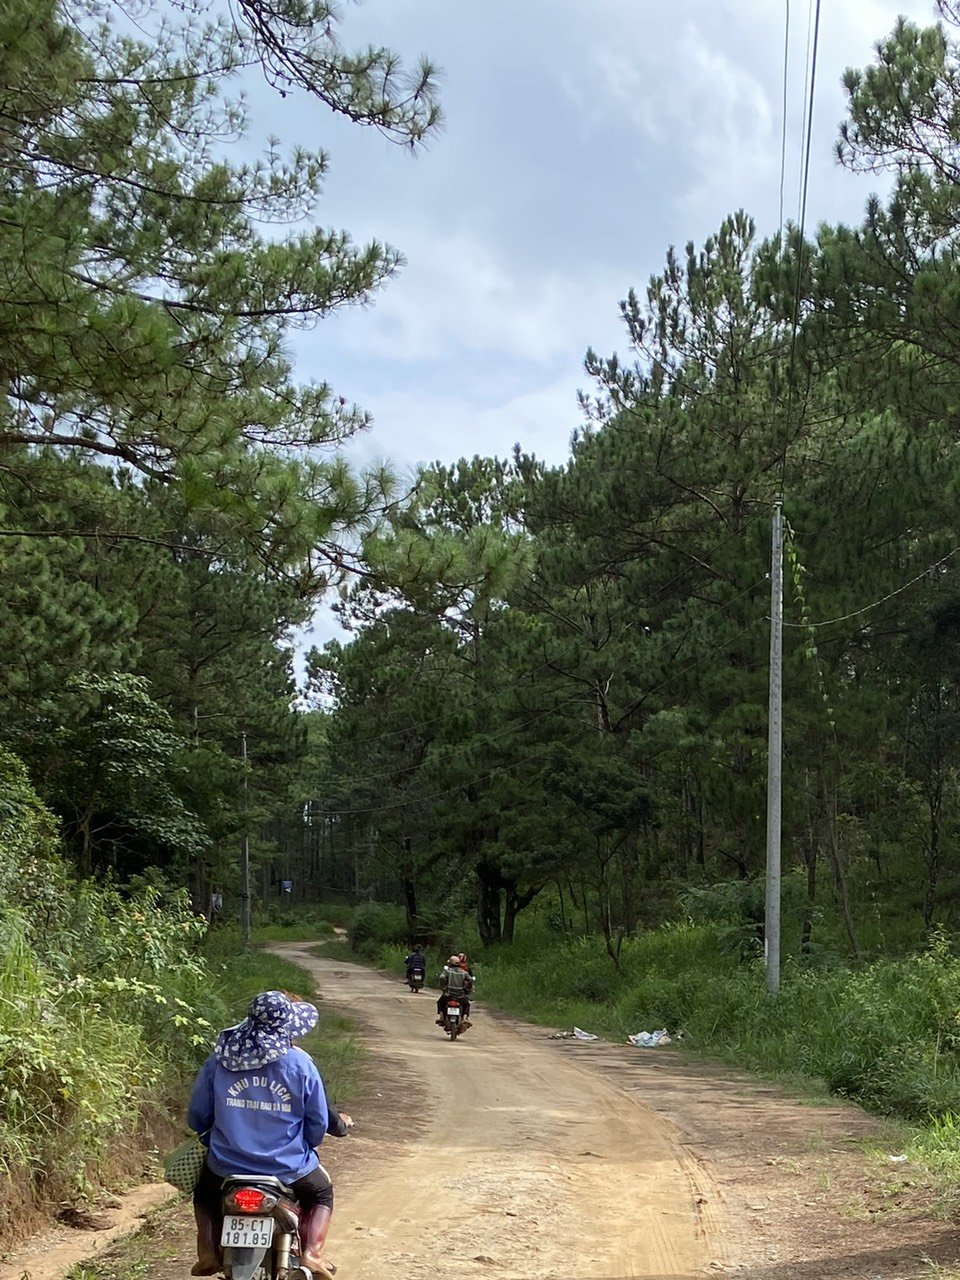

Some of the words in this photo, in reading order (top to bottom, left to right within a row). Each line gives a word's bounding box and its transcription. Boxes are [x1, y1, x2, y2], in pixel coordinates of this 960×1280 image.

[227, 1077, 249, 1097] KHU
[252, 1076, 268, 1087] DU
[269, 1080, 292, 1102] LỊCH
[230, 1218, 264, 1232] 85-C1
[226, 1231, 268, 1246] 181.85
